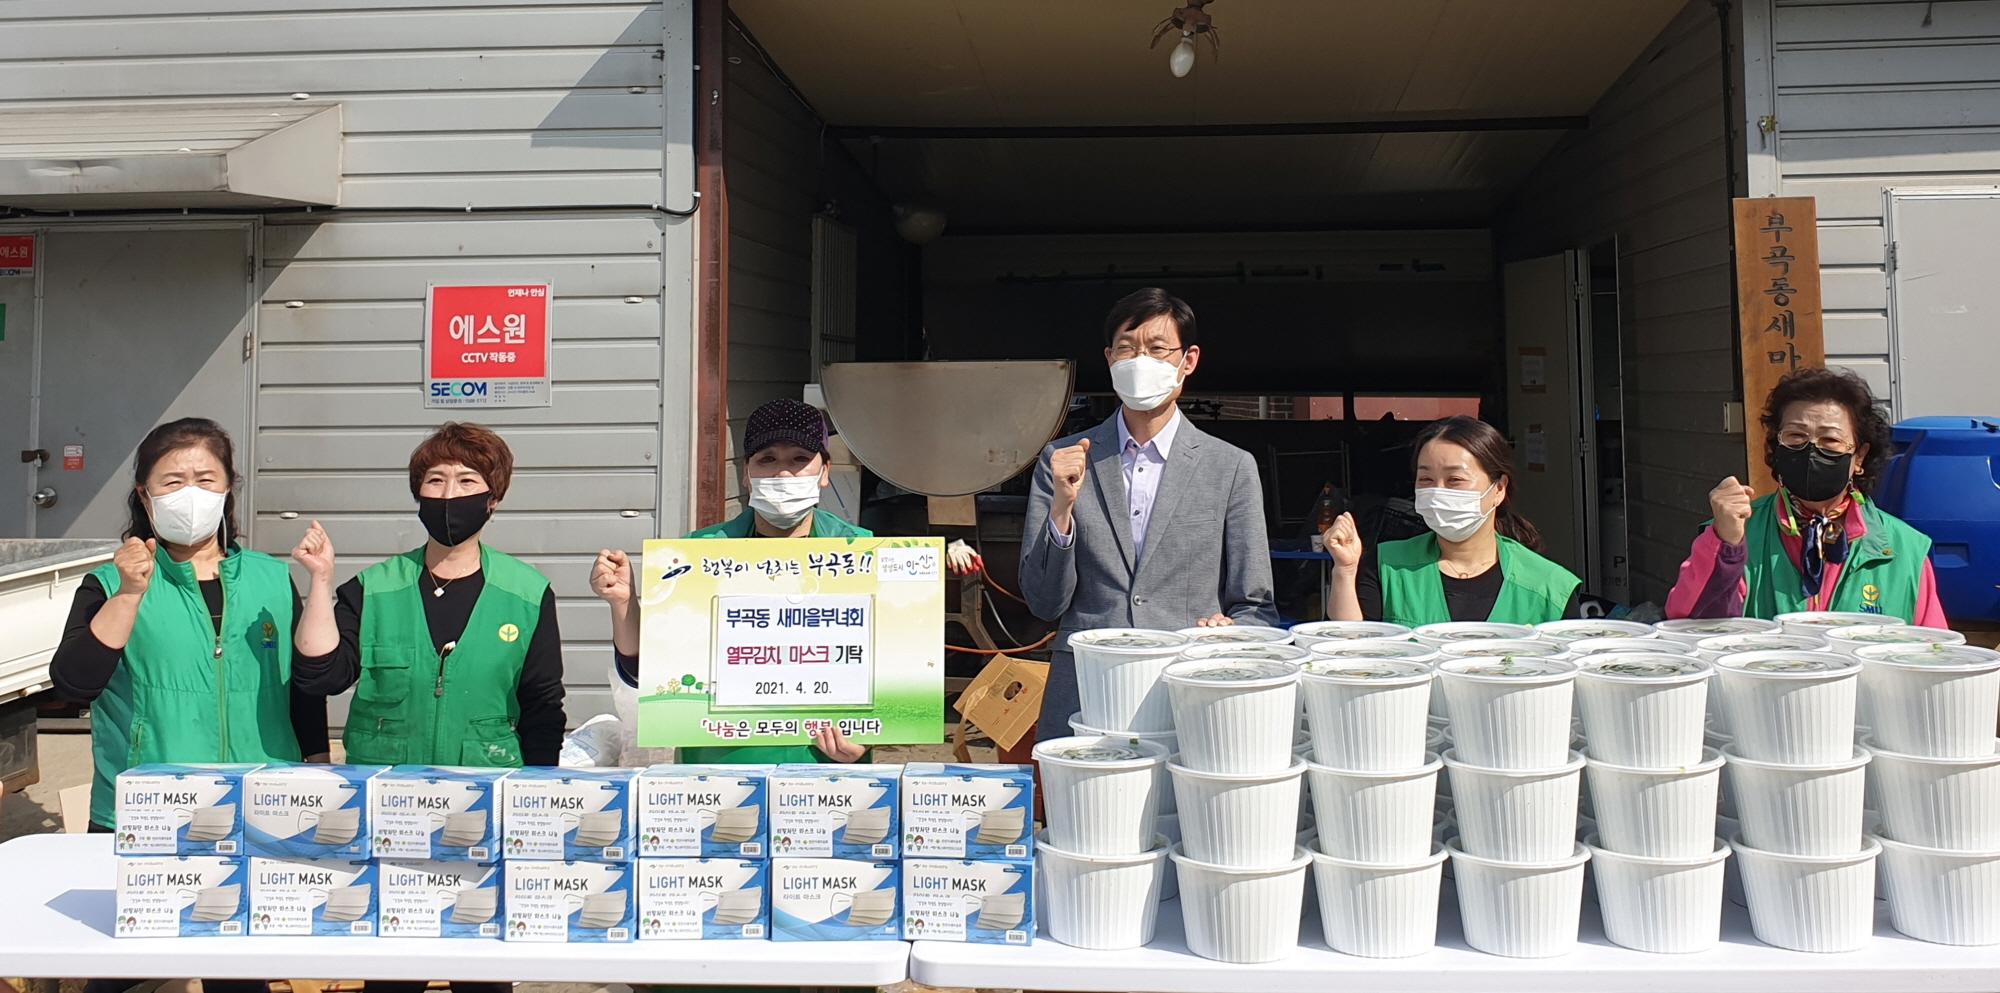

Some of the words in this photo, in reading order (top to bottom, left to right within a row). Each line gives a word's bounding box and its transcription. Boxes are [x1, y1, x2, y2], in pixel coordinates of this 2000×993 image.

[507, 289, 529, 297] 언제나
[530, 288, 545, 297] 안심
[449, 314, 526, 345] 에스원
[461, 353, 488, 363] CCTV
[489, 352, 516, 363] 작동중
[430, 382, 487, 396] SECOM
[702, 558, 748, 578] 행복이
[757, 560, 800, 575] 넘치는
[808, 553, 872, 577] 부곡동!!
[726, 608, 771, 628] 부곡동
[777, 607, 864, 628] 새마을부녀회
[789, 645, 830, 664] 마스크
[835, 645, 864, 664] 기탁
[755, 681, 789, 694] 2021.
[795, 681, 807, 694] 4.
[814, 681, 832, 694] 20.
[756, 720, 798, 735] 모두의
[839, 720, 880, 736] 입니다
[125, 793, 160, 805] LIGHT
[163, 793, 198, 805] MASK
[254, 794, 287, 806] LIGHT
[290, 795, 323, 807] MASK
[381, 795, 414, 807] LIGHT
[417, 797, 450, 809] MASK
[512, 796, 546, 808] LIGHT
[550, 797, 584, 809] MASK
[649, 794, 683, 805] LIGHT
[687, 794, 721, 805] MASK
[779, 794, 814, 806] LIGHT
[818, 795, 852, 806] MASK
[913, 794, 948, 806] LIGHT
[952, 795, 986, 806] MASK
[127, 874, 163, 886] LIGHT
[167, 874, 202, 885] MASK
[260, 873, 295, 885] LIGHT
[298, 873, 332, 885] MASK
[389, 874, 424, 886] LIGHT
[427, 874, 461, 886] MASK
[515, 878, 550, 891] LIGHT
[554, 879, 588, 891] MASK
[649, 876, 684, 888] LIGHT
[688, 876, 723, 888] MASK
[783, 877, 818, 889] LIGHT
[822, 877, 857, 889] MASK
[913, 876, 948, 889] LIGHT
[952, 878, 986, 891] MASK
